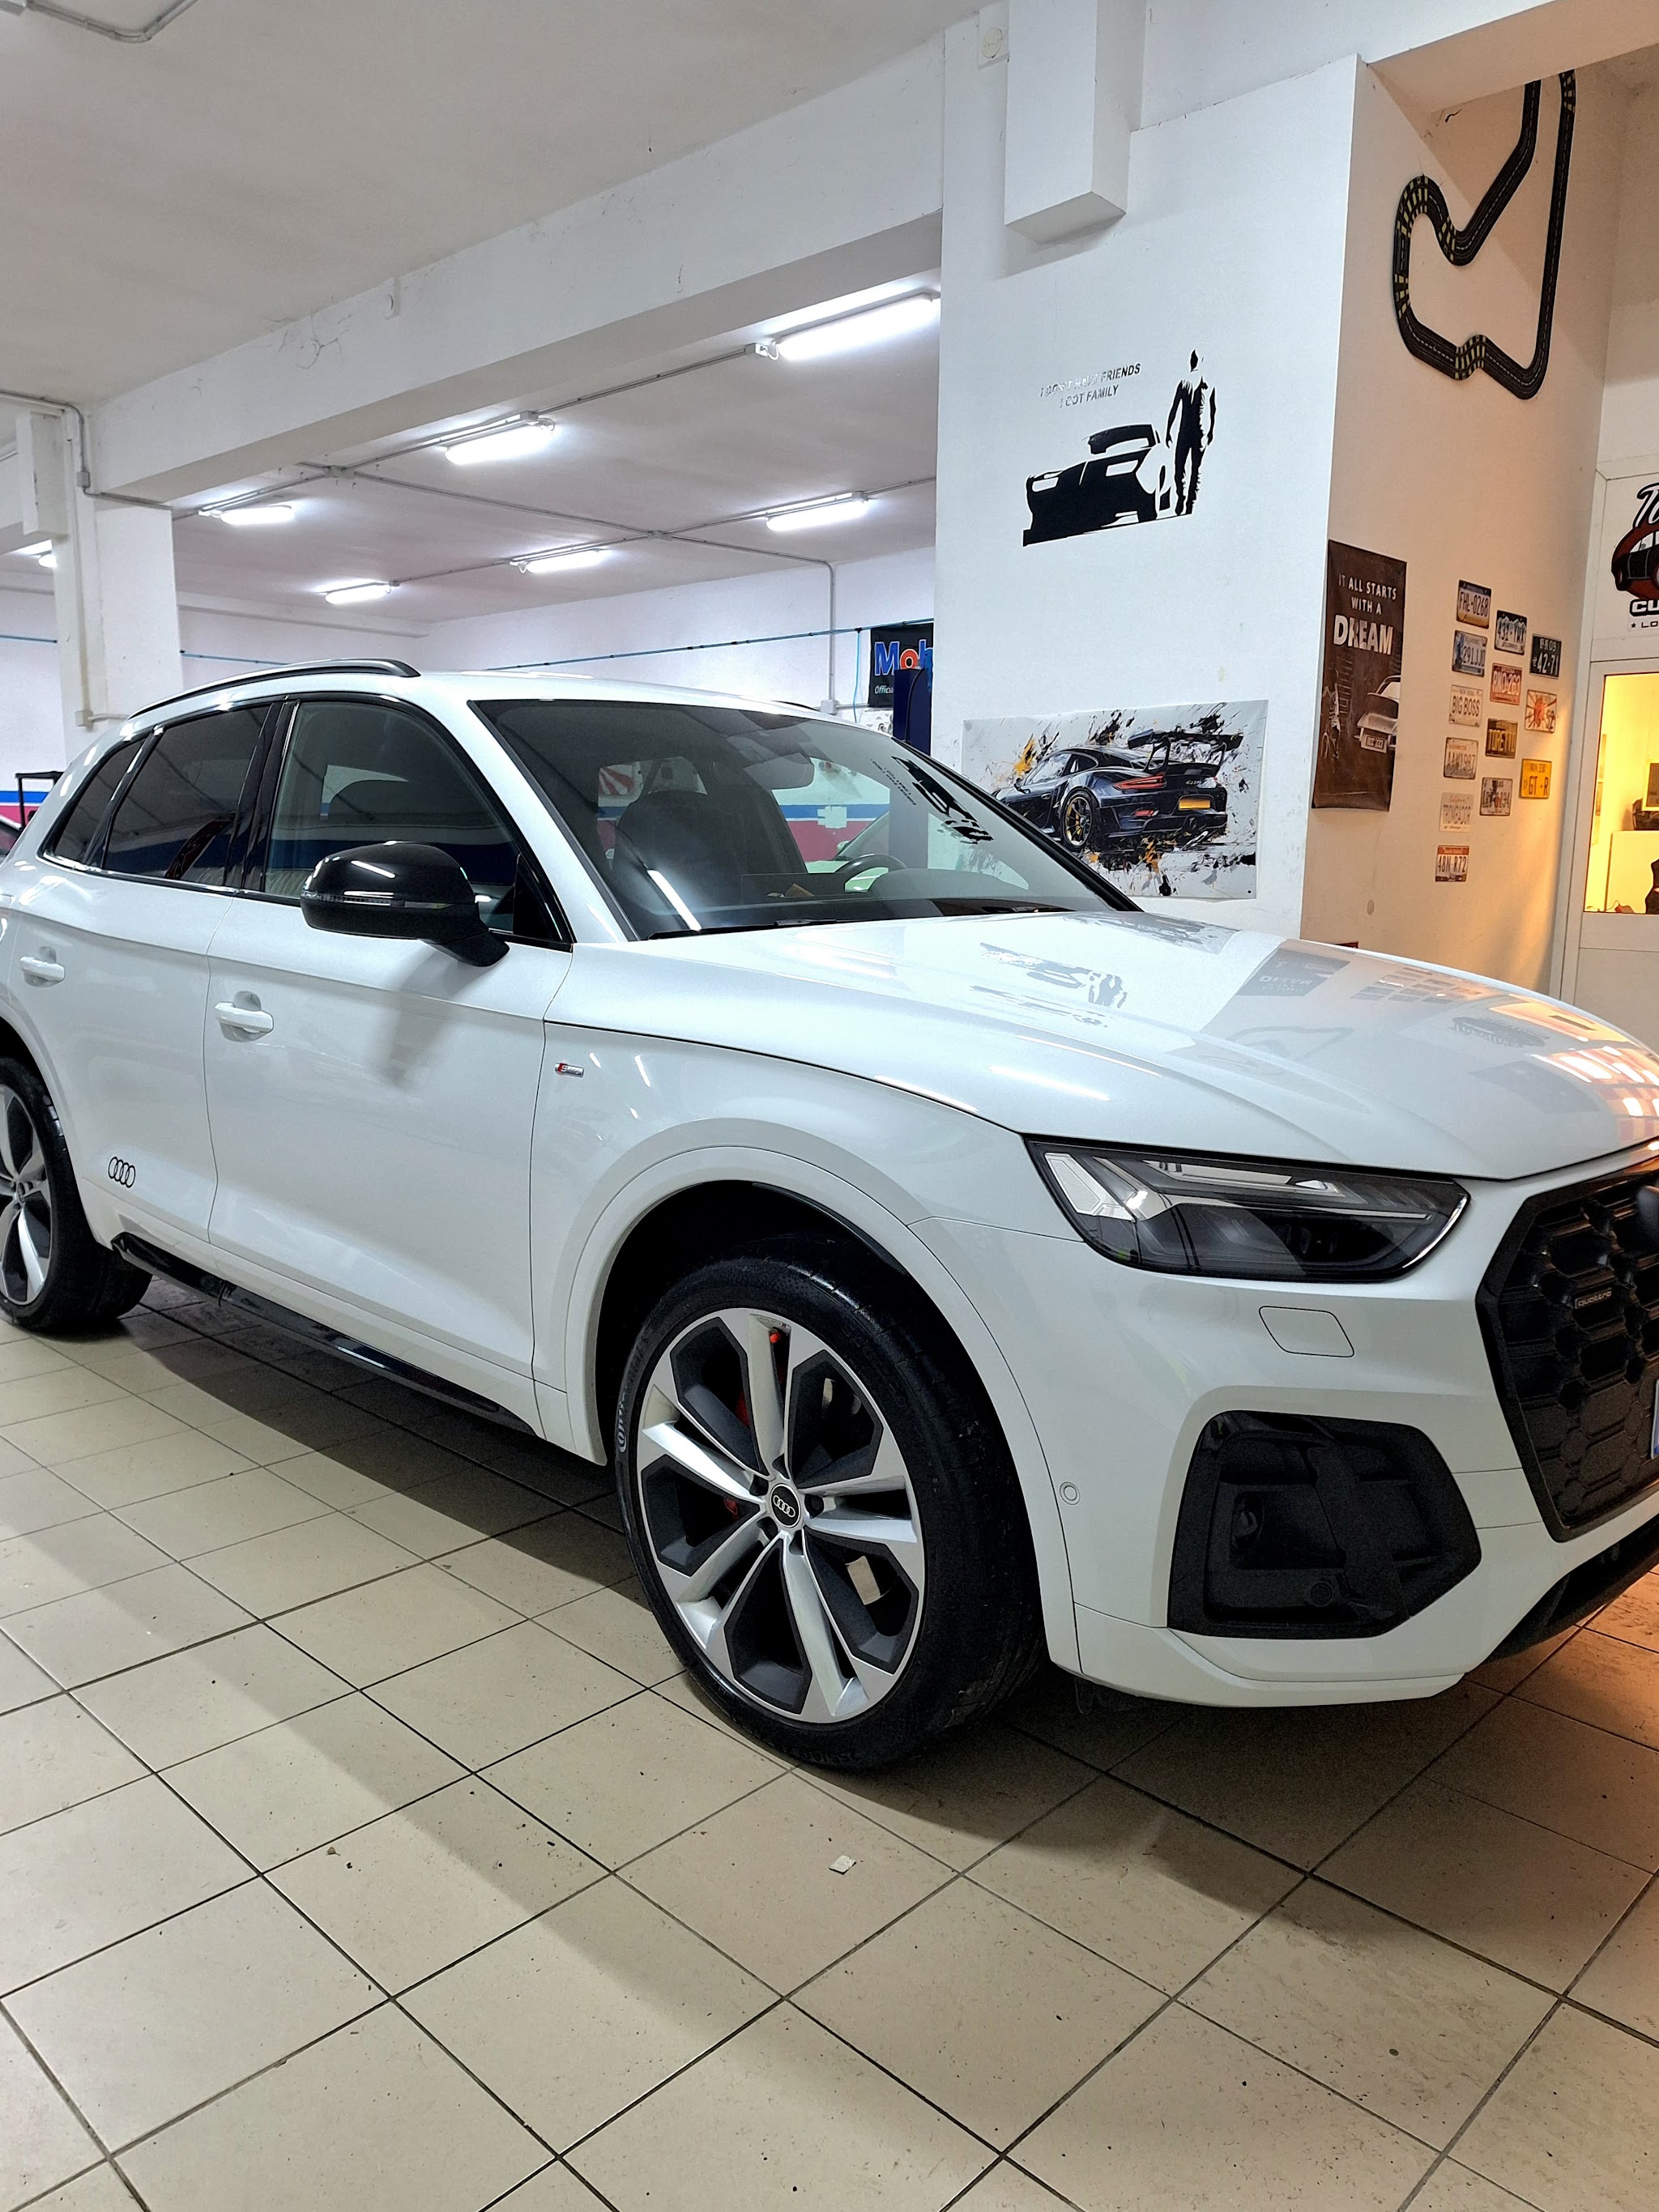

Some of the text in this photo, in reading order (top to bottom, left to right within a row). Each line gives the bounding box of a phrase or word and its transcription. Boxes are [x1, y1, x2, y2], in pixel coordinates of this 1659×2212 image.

[1101, 363, 1141, 382] FRIENDS
[1086, 384, 1119, 402] FAMILY
[1338, 573, 1397, 599] IT ALL STARTS
[1351, 596, 1382, 616] WITH A
[1333, 614, 1393, 655] DREAM
[1452, 696, 1480, 717] BIG BOSS
[1578, 1291, 1612, 1306] quattro
